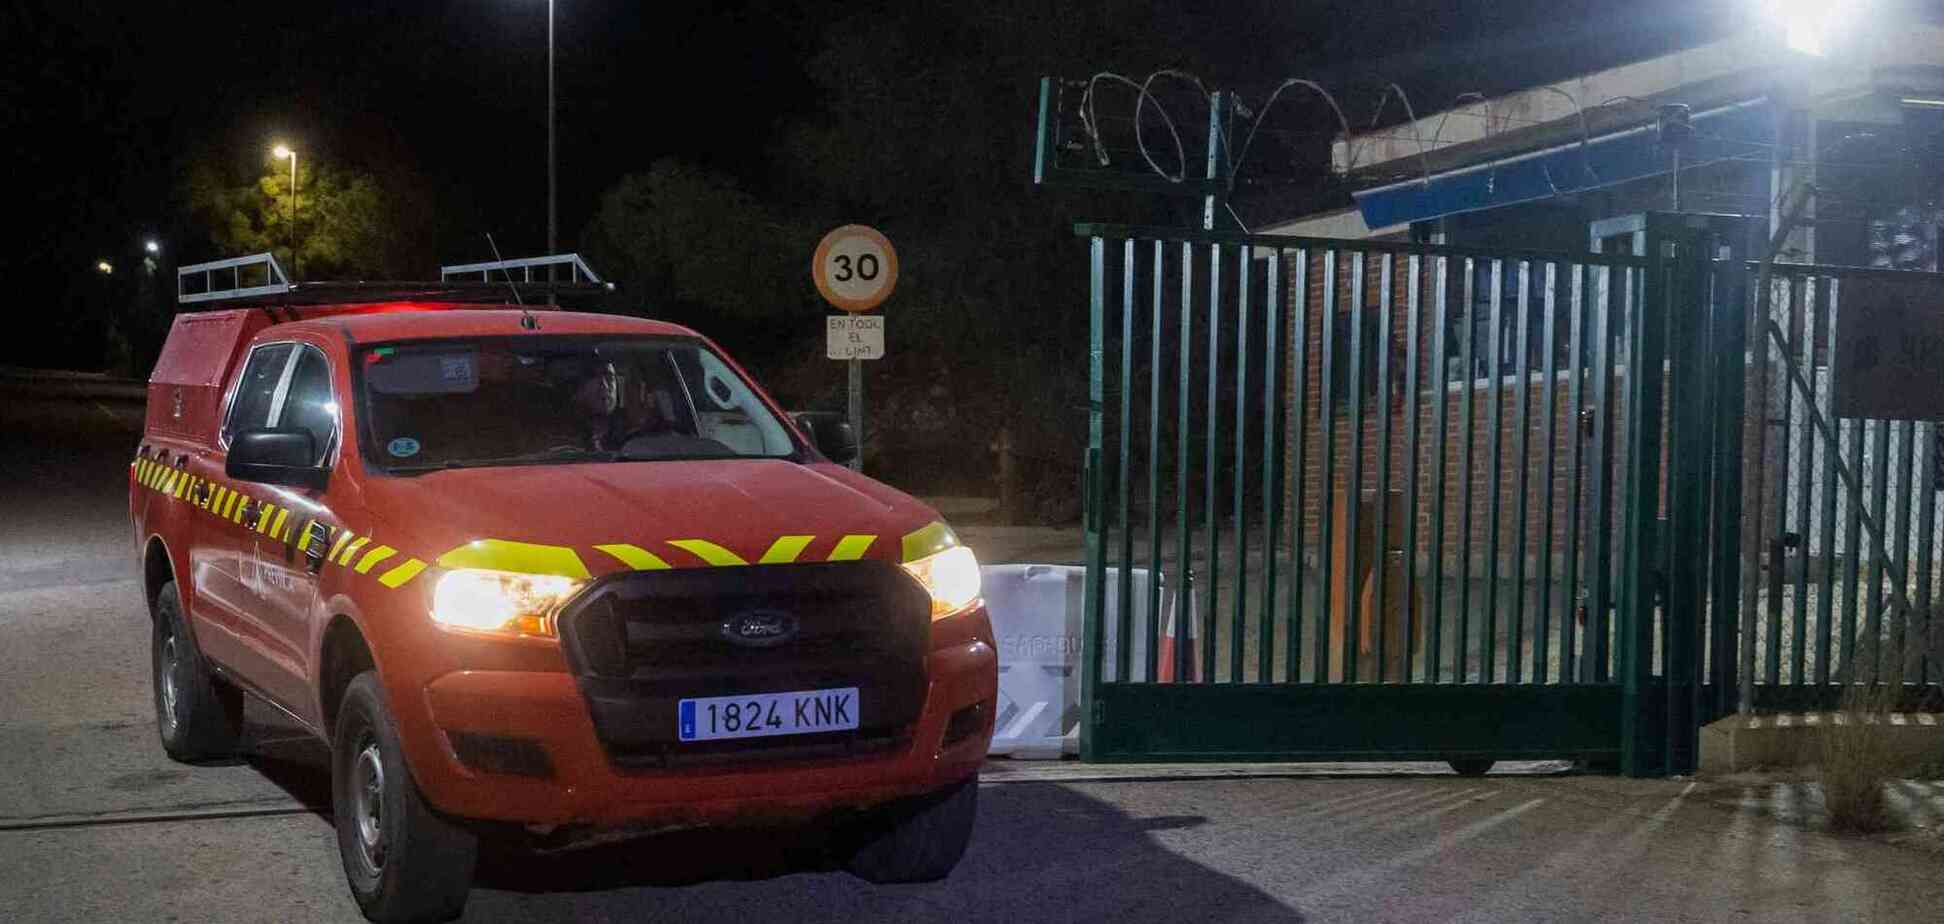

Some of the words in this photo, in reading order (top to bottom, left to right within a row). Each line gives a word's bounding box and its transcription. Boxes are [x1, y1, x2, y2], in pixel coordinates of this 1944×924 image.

[833, 254, 879, 282] 30
[831, 319, 846, 329] EN
[707, 701, 783, 733] 1824
[795, 694, 850, 728] KNK
